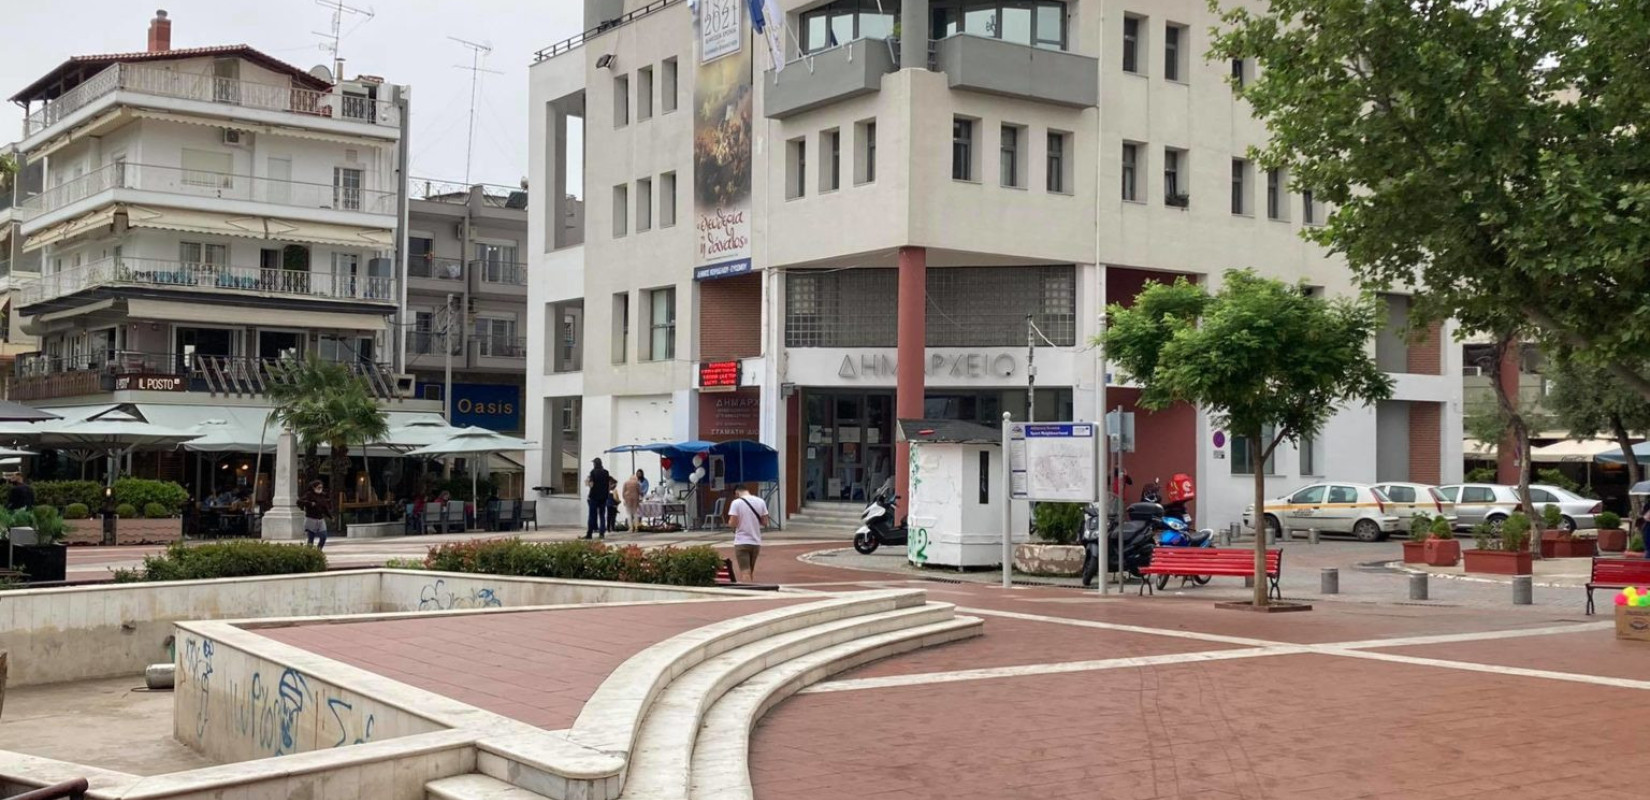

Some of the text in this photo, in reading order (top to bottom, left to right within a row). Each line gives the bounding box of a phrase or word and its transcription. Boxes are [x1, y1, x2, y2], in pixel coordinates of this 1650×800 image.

[704, 5, 737, 37] 2021
[838, 353, 1016, 378] ΔΗΜΡΧΕΙΟ
[147, 378, 174, 390] POSTO
[458, 398, 513, 415] Oasis
